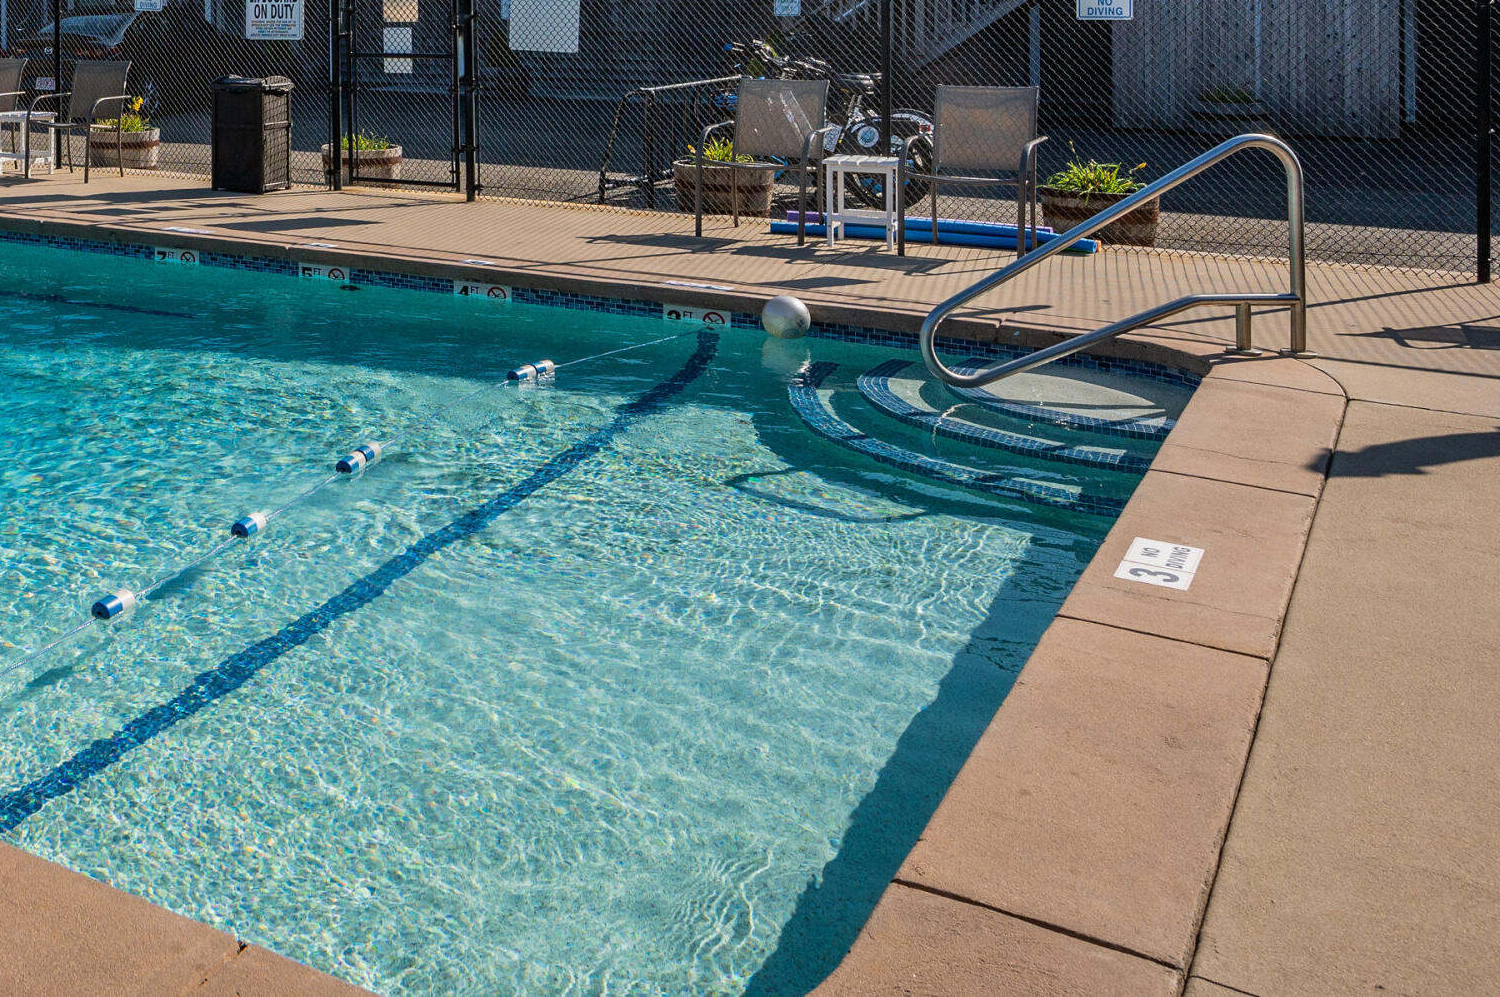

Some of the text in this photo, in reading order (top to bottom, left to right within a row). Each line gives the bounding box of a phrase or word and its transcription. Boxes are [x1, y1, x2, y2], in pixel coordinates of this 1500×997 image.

[254, 4, 295, 19] ON DUTY
[1087, 7, 1123, 16] DIVING
[157, 251, 167, 261] 7
[301, 267, 322, 277] 5 FT
[457, 285, 480, 296] 4 FT
[683, 310, 693, 319] FT
[1140, 547, 1161, 558] NO
[1165, 546, 1191, 569] DIVING
[1128, 567, 1180, 583] 3
